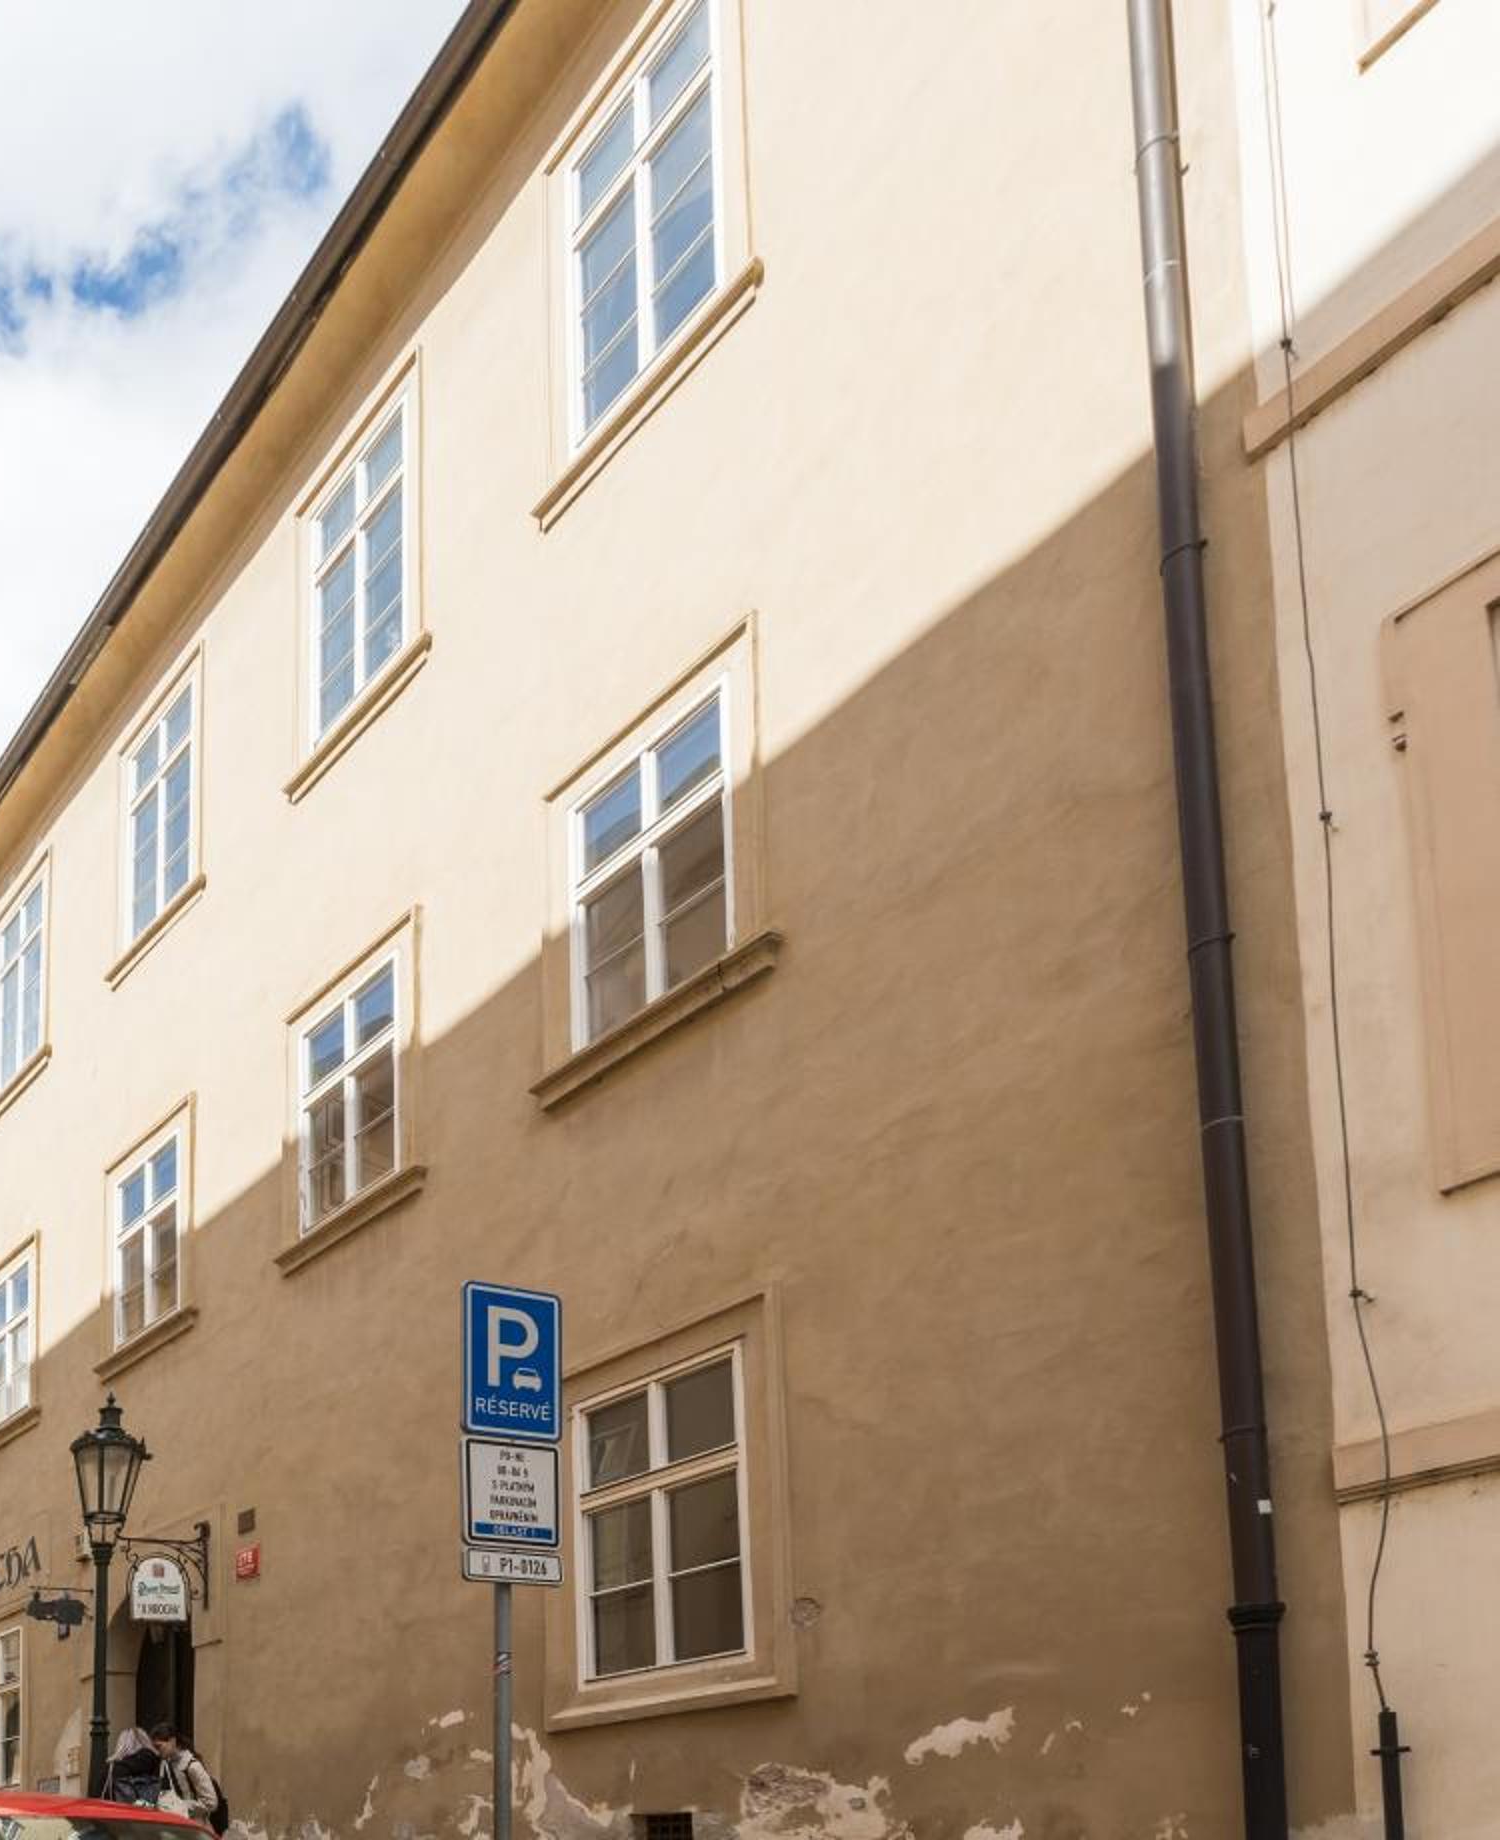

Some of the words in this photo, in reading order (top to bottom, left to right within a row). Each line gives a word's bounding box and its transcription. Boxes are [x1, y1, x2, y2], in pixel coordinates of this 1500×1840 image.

[487, 1305, 540, 1387] P
[475, 1395, 553, 1421] RÉSERVÉ
[499, 1557, 548, 1576] P1-0126
